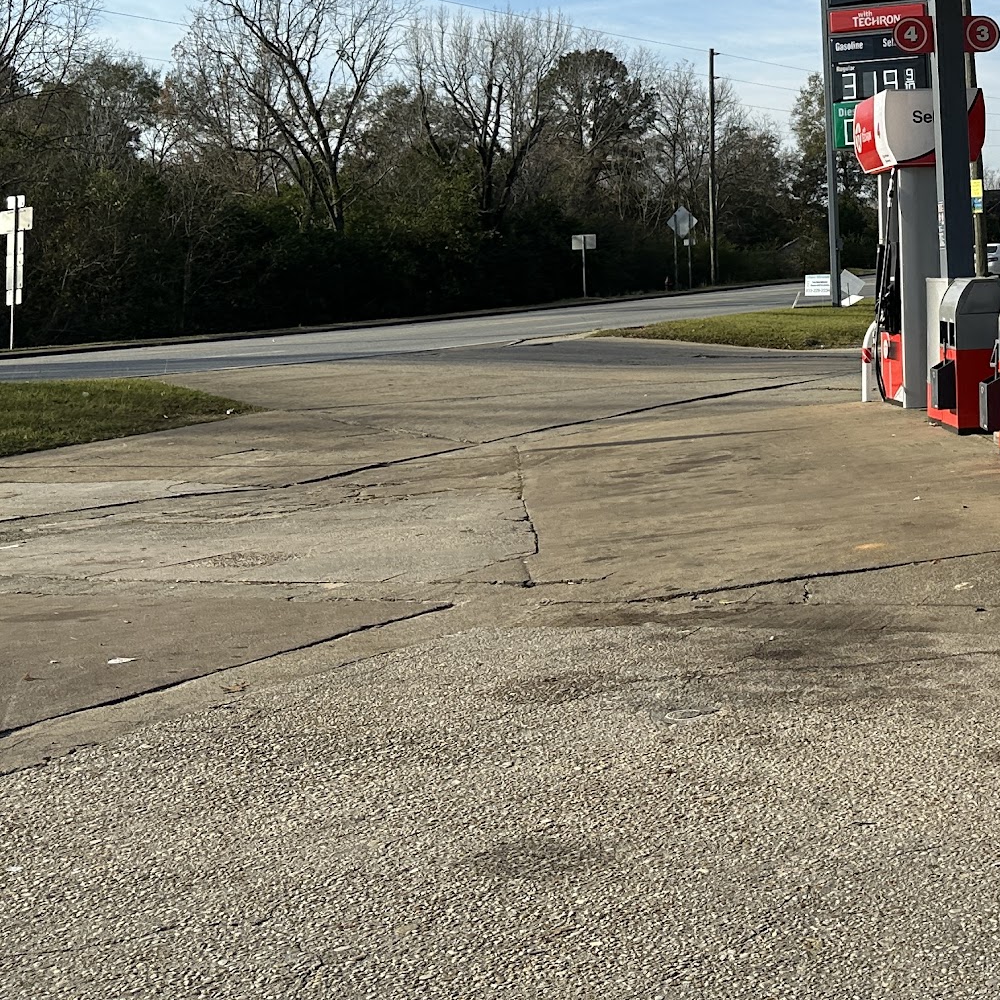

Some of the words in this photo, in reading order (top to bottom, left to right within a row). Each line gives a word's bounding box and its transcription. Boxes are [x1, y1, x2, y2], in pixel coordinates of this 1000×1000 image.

[852, 14, 901, 27] TECHRON
[904, 26, 918, 42] 4
[976, 25, 990, 42] 3
[835, 41, 864, 51] Gasoline
[882, 38, 897, 47] Sel
[912, 110, 934, 123] Se
